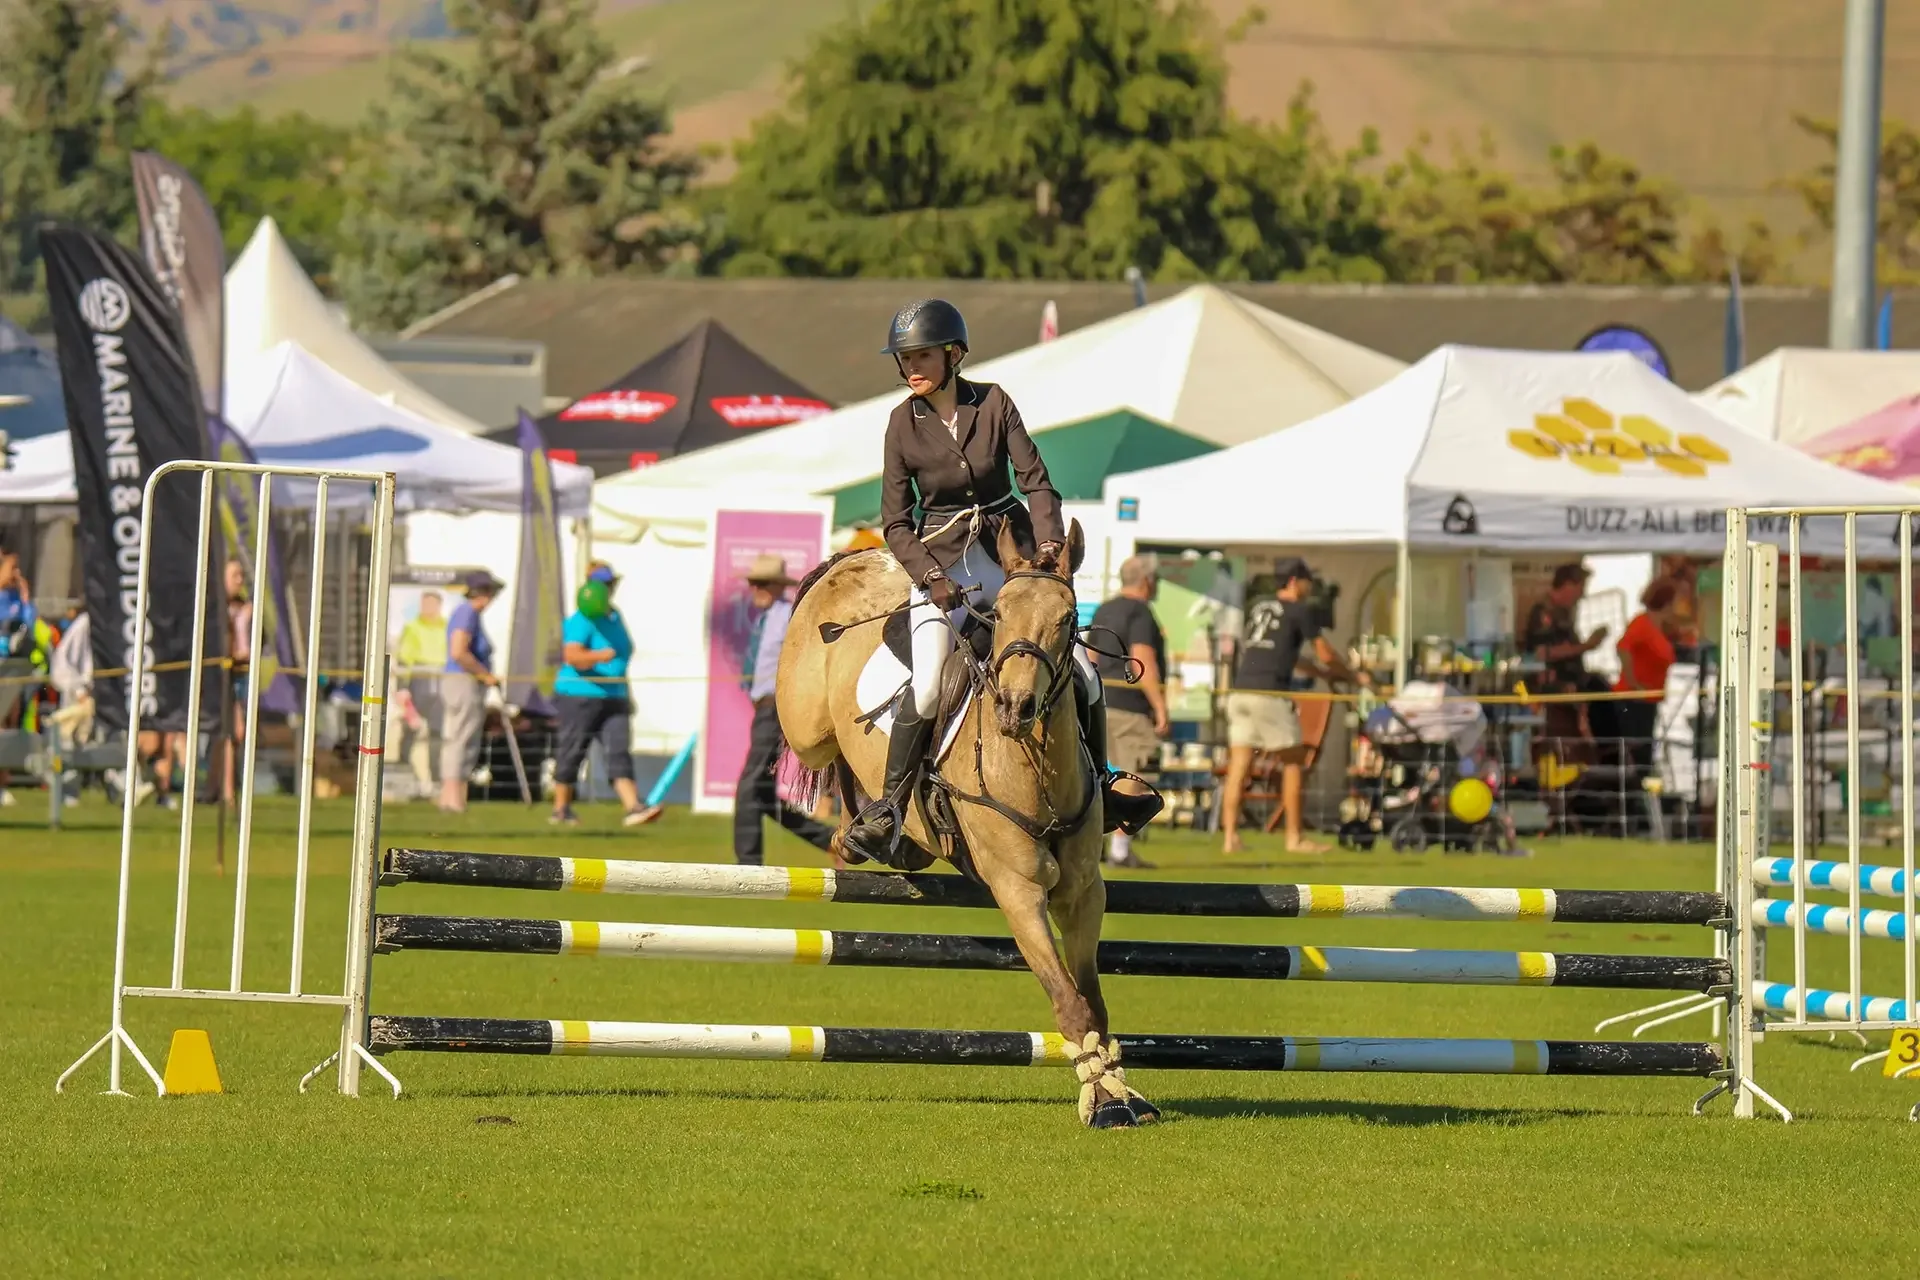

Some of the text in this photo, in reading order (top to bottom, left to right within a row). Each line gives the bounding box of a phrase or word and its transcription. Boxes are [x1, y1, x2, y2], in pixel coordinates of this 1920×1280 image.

[92, 333, 141, 480] MARINE
[109, 484, 143, 515] &
[1694, 508, 1809, 536] BEWAX
[1898, 1032, 1920, 1064] 3
